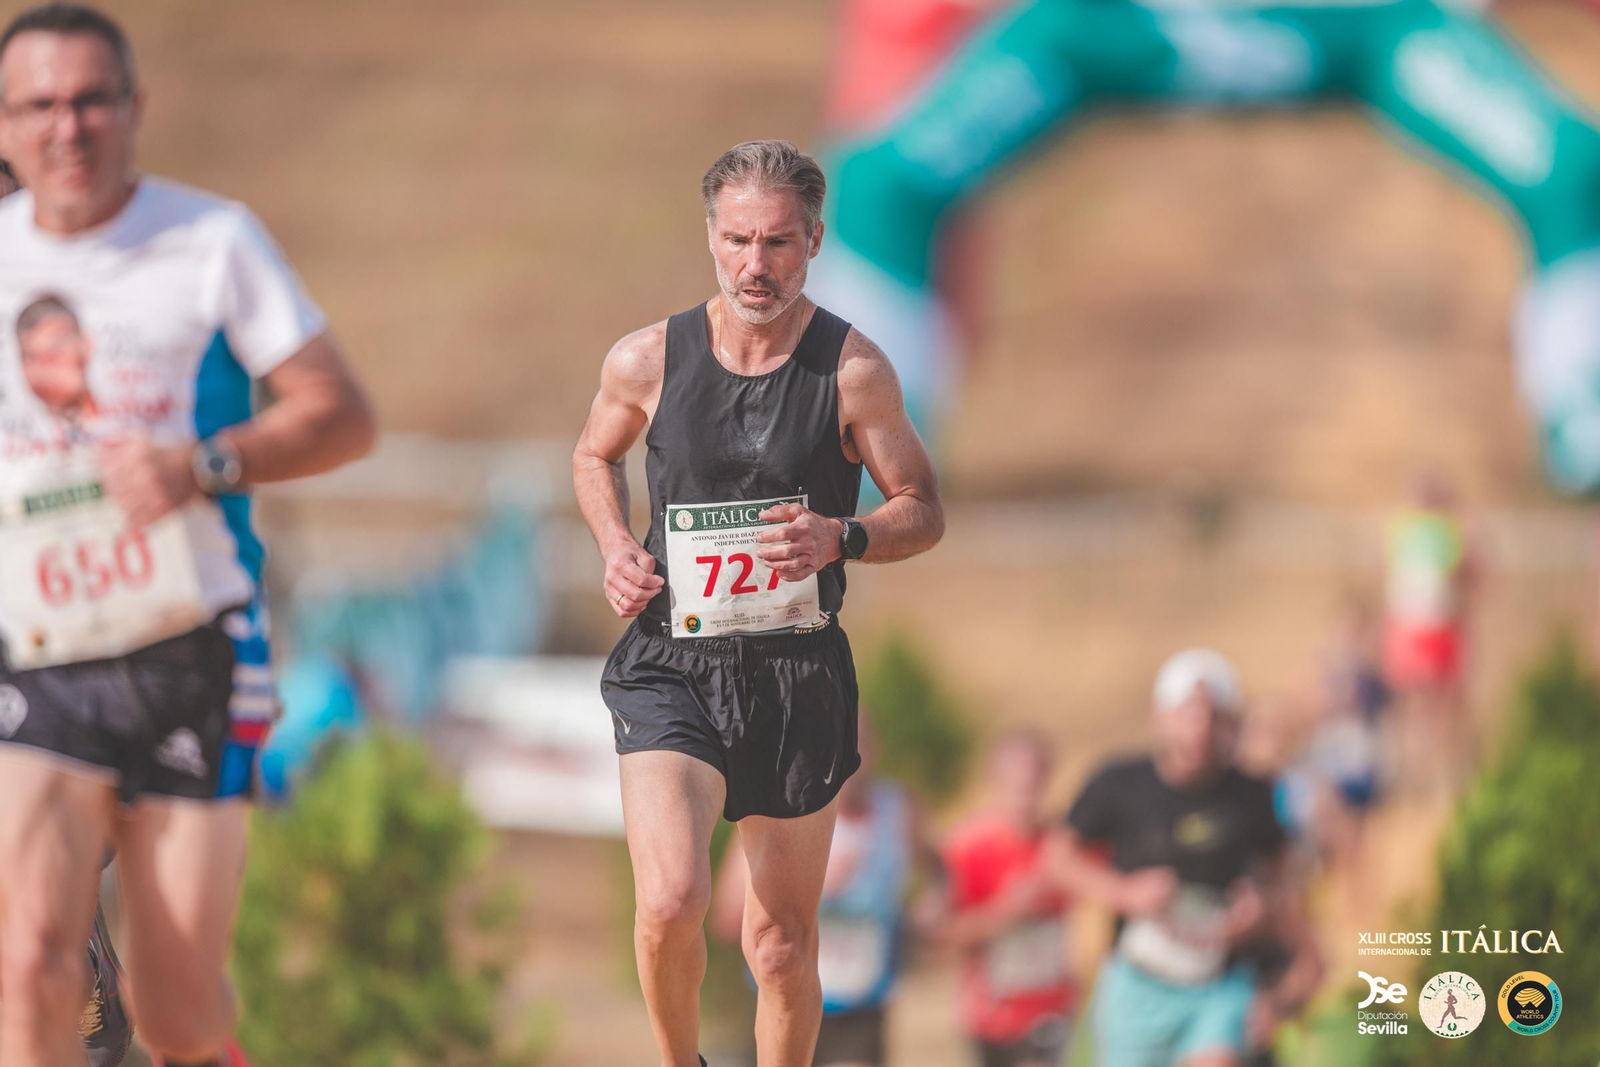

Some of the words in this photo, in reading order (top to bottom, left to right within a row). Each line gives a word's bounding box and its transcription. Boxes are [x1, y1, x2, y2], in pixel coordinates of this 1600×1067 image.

[702, 508, 765, 525] ITÁLIC
[691, 534, 717, 542] ANTONIO
[36, 526, 154, 608] 650
